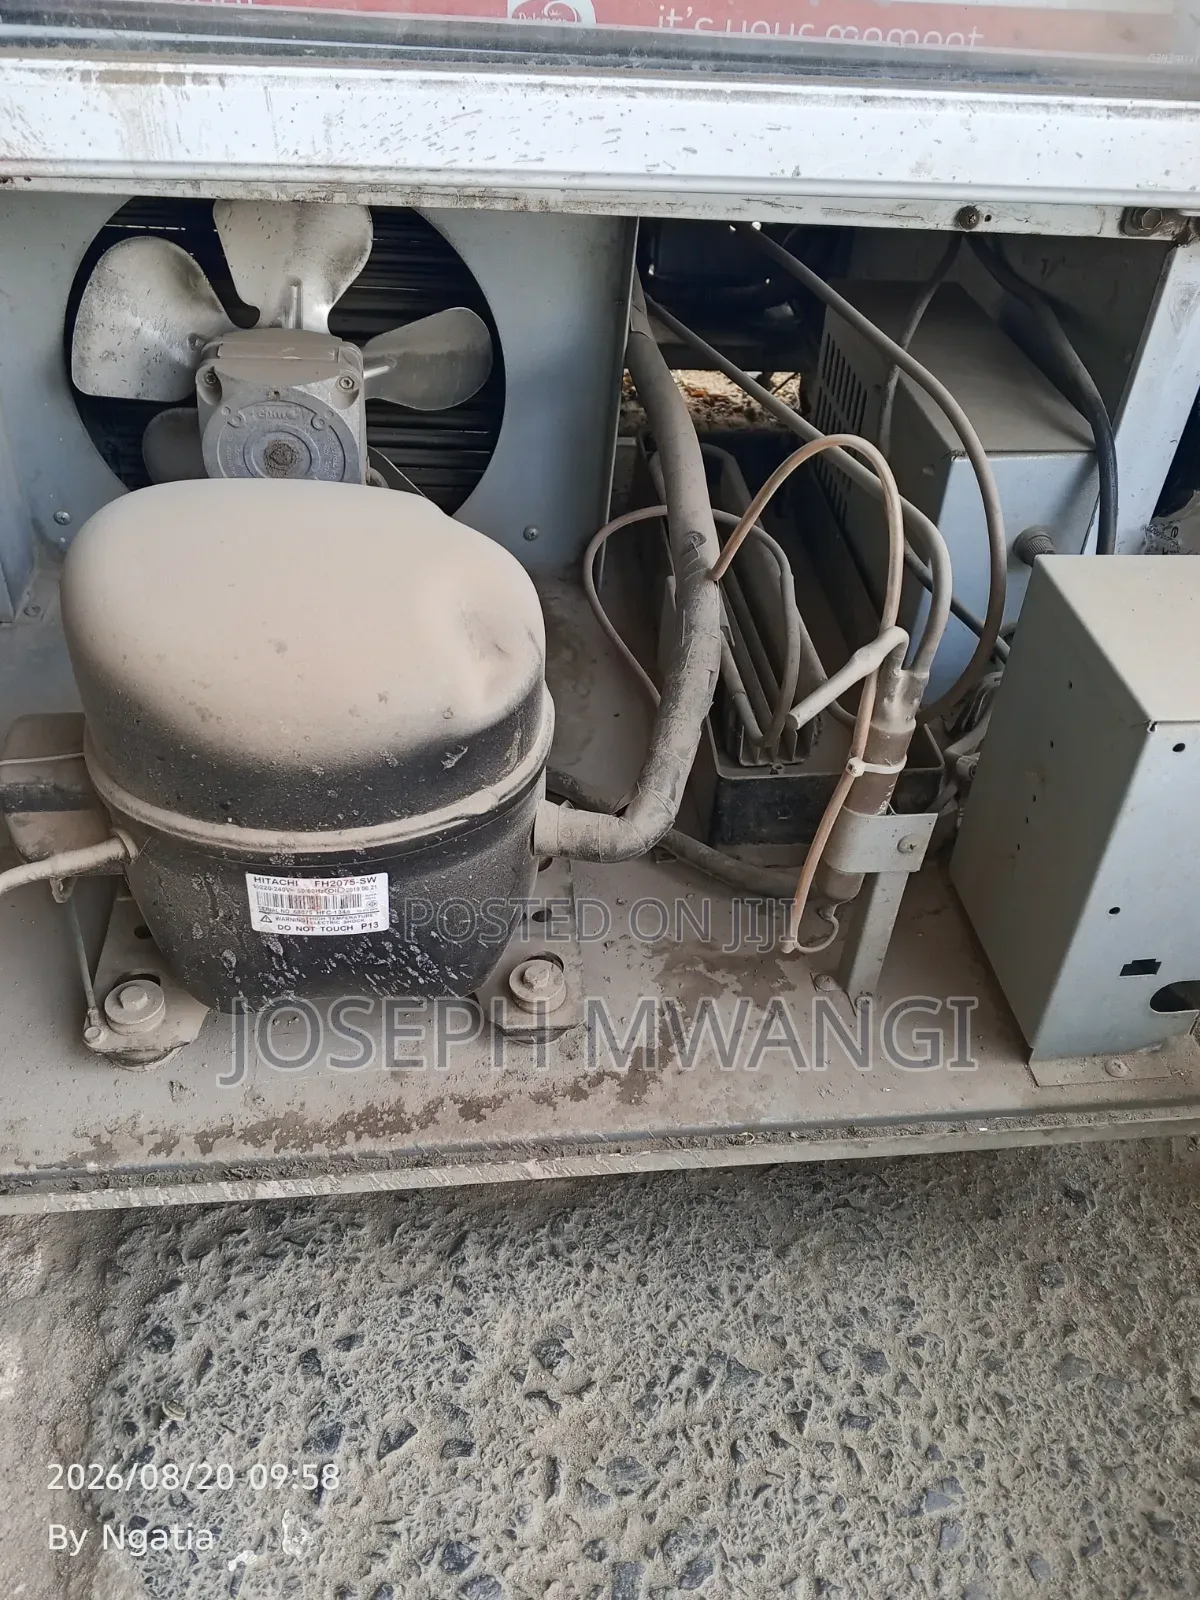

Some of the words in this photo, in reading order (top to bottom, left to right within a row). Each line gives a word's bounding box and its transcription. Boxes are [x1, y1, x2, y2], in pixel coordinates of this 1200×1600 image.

[253, 876, 298, 887] HITACHI
[314, 876, 378, 888] FH2075-SW
[275, 915, 306, 923] WARNING
[329, 913, 374, 921] TEMPERATURE
[321, 924, 354, 932] TOUCH
[360, 921, 379, 930] P13
